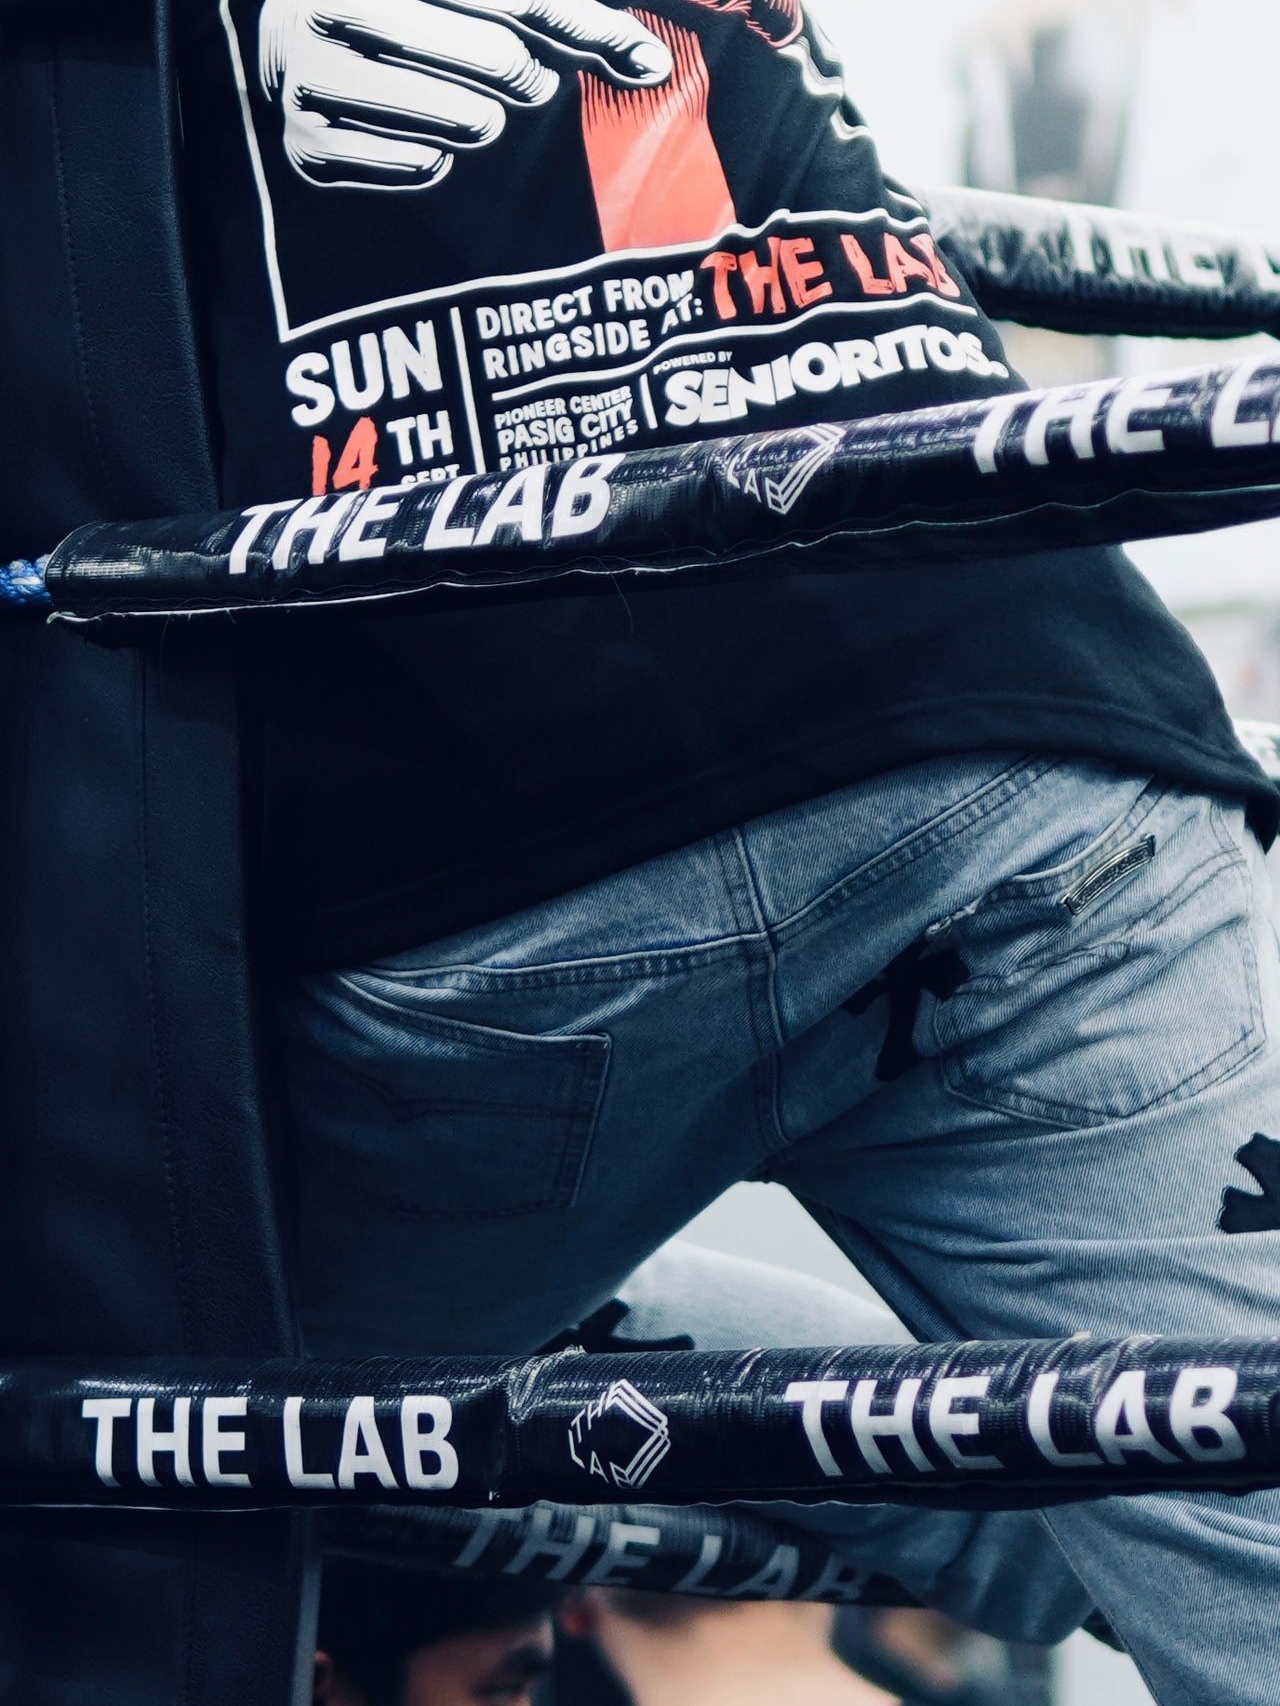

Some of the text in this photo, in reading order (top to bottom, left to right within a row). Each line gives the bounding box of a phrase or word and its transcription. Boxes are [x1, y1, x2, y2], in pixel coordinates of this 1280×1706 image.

[476, 270, 694, 339] DIRECT FROM
[699, 236, 833, 320] THE
[840, 232, 960, 297] LAB
[286, 320, 443, 427] SUN
[483, 319, 651, 379] RINGSIDE
[652, 350, 734, 375] POWERED BY
[494, 386, 632, 429] PIONEER CENTER
[498, 400, 632, 453] PASIG CITY
[500, 420, 638, 472] PHILIPPINES
[973, 383, 1171, 473] THE
[312, 410, 454, 496] 14 TH
[229, 453, 628, 574] THE LAB
[81, 1395, 460, 1490] THE LAB
[568, 1429, 632, 1489] LAB
[783, 1366, 1247, 1477] THE LAB
[454, 1507, 661, 1584] THE
